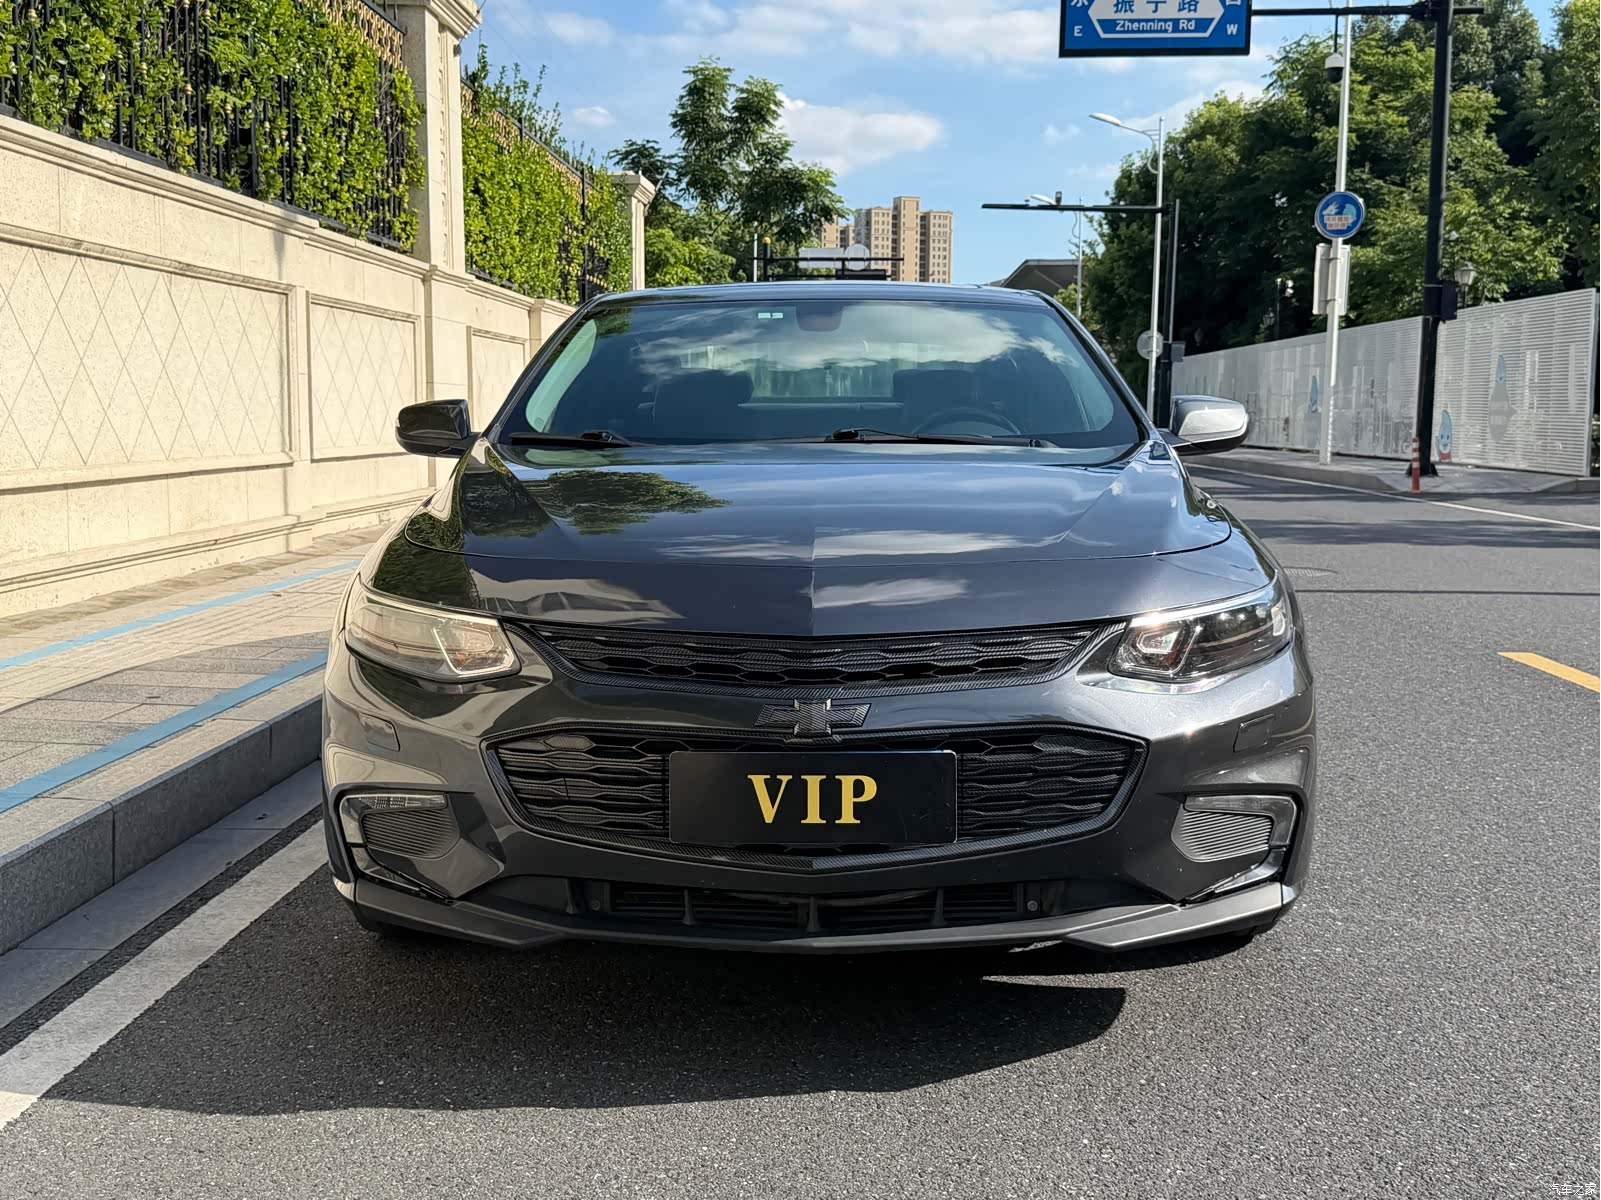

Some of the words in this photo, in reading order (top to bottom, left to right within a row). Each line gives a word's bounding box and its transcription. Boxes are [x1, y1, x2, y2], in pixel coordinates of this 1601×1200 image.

[1073, 25, 1083, 37] E
[1115, 20, 1173, 33] Zhenning
[1179, 20, 1196, 31] Rd
[1226, 24, 1238, 36] W
[747, 774, 878, 824] VIP
